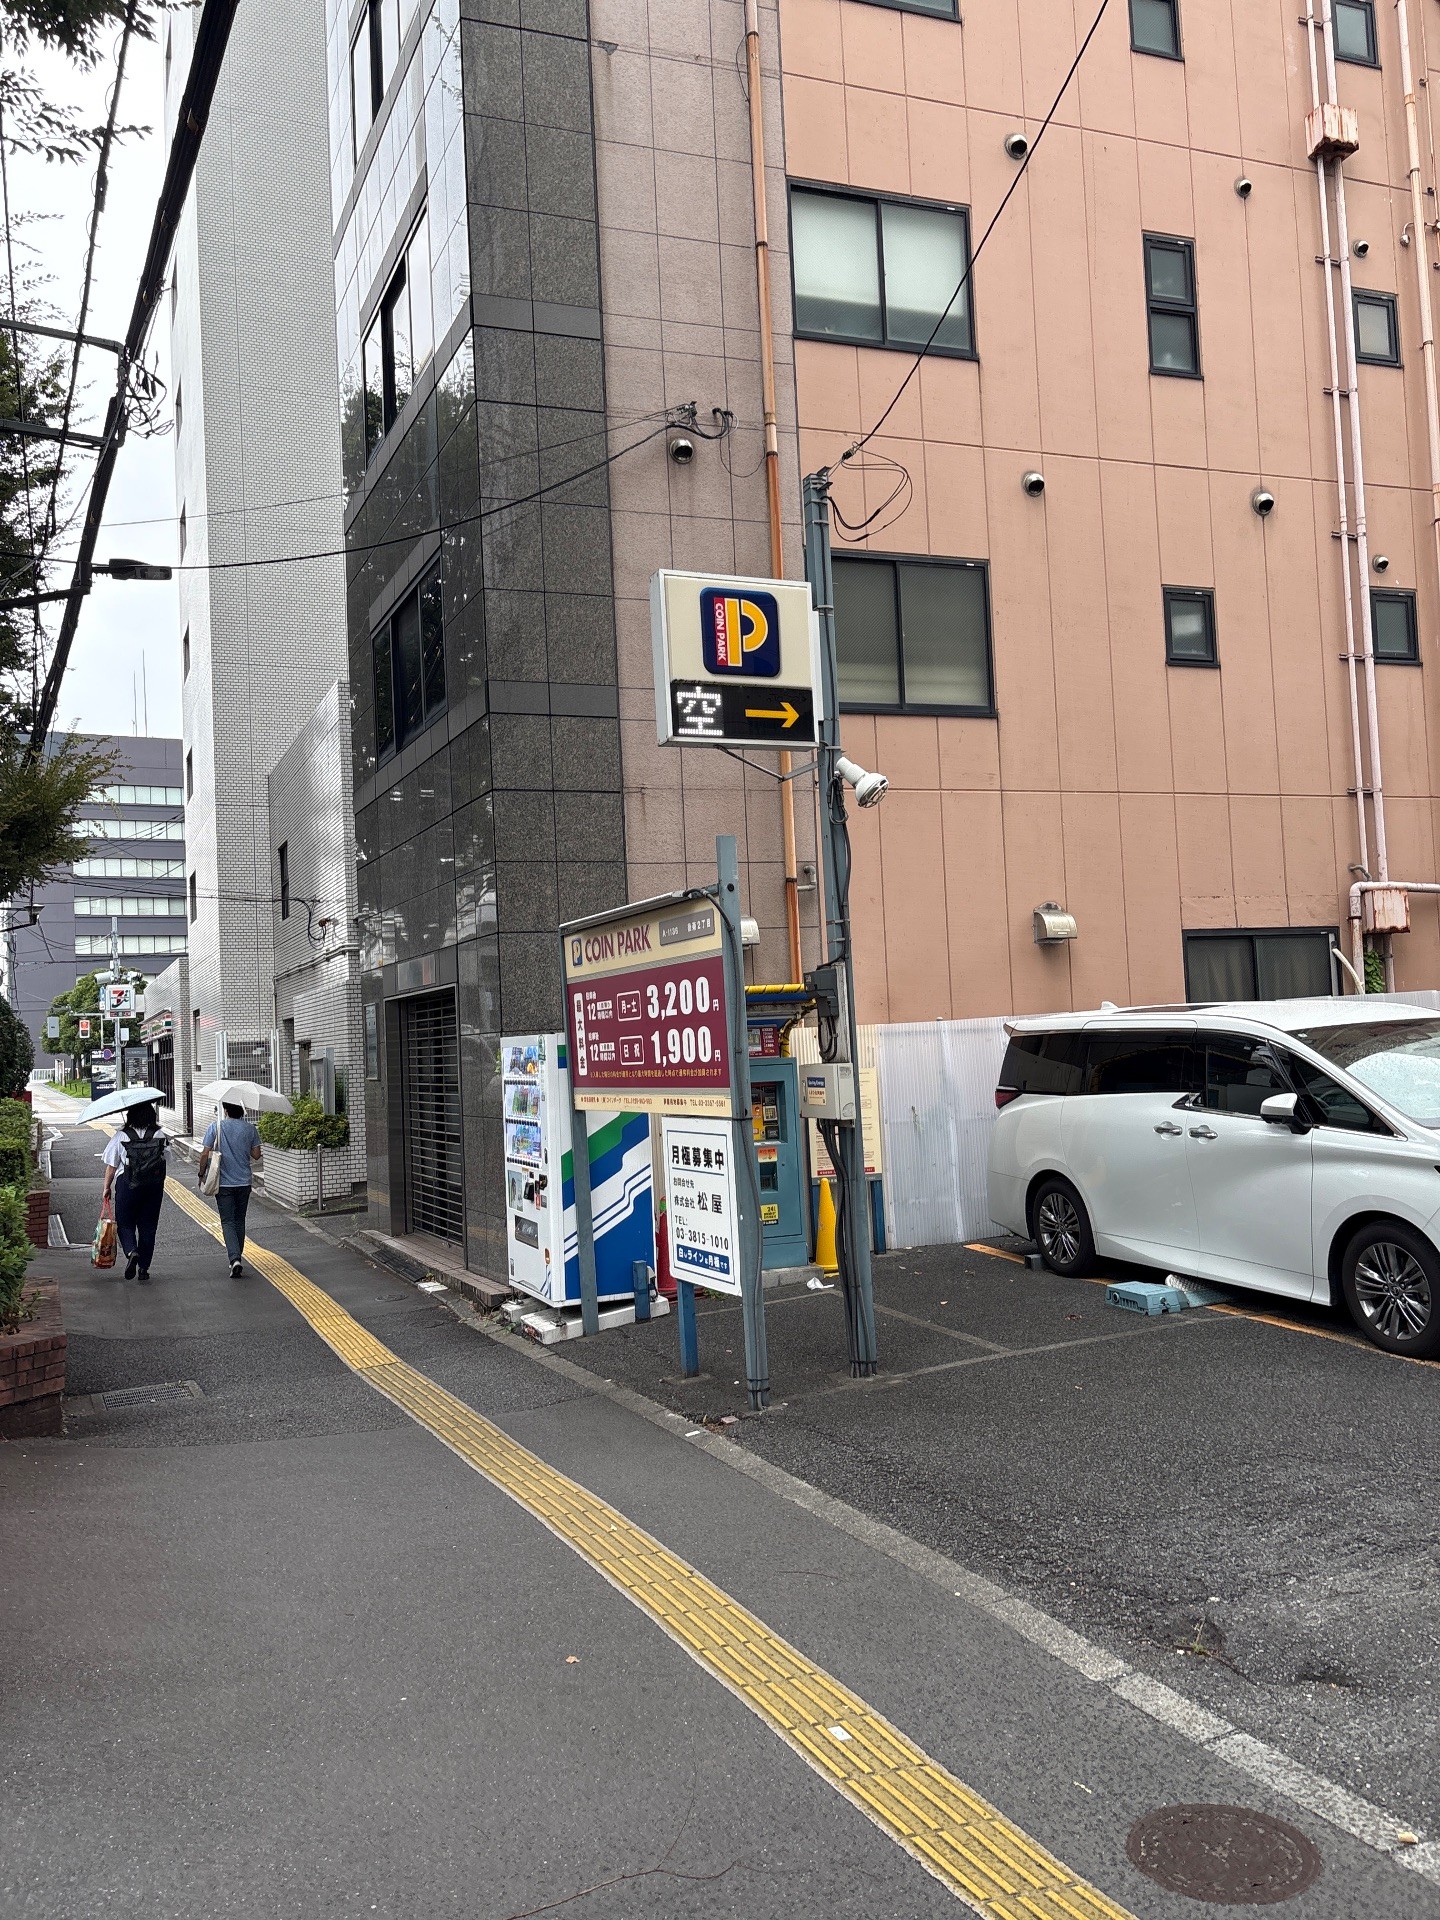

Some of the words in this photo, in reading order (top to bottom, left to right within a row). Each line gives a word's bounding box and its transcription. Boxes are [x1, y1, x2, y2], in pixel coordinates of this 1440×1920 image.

[714, 602, 725, 631] COIN
[716, 632, 727, 661] PARK
[677, 686, 723, 735] 空
[585, 935, 615, 962] COIN
[618, 924, 651, 957] PARK
[587, 1003, 597, 1020] 12
[590, 1043, 599, 1061] 12
[672, 1145, 724, 1170] 月極募集中
[674, 1195, 695, 1209] 株式会社
[698, 1190, 723, 1214] 松屋
[676, 1227, 729, 1250] 03-3815-1010
